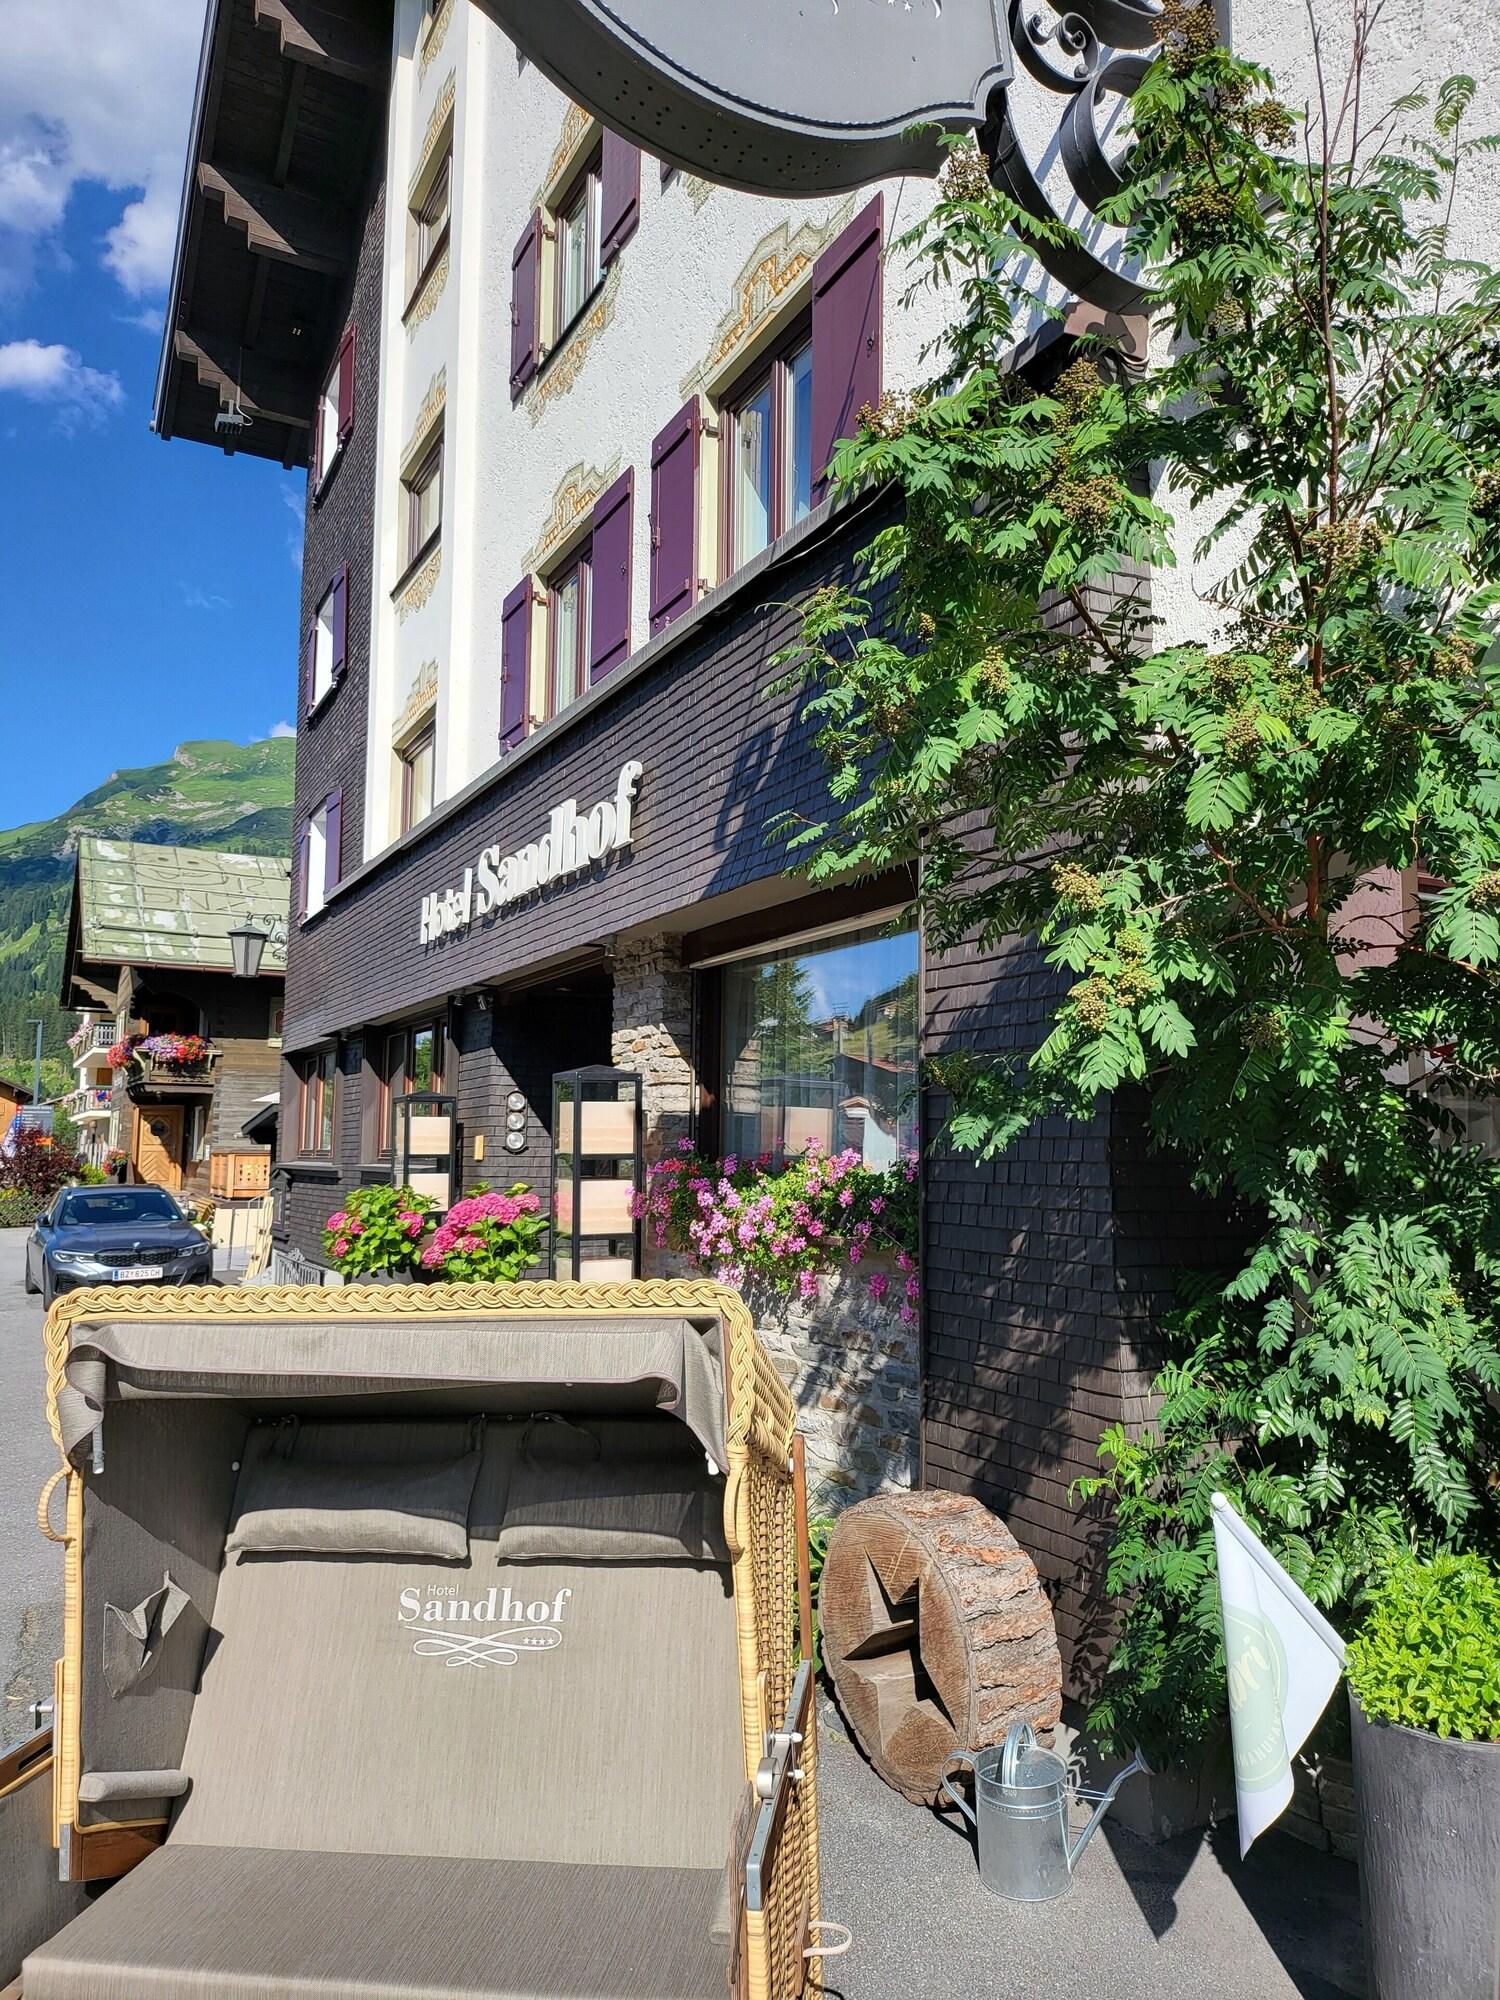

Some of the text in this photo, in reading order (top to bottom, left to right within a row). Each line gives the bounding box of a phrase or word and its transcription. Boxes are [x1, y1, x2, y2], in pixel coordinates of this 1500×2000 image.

[420, 760, 642, 944] Hotel Sandhof
[398, 1588, 571, 1622] Sandhof
[427, 1584, 459, 1596] Hotel
